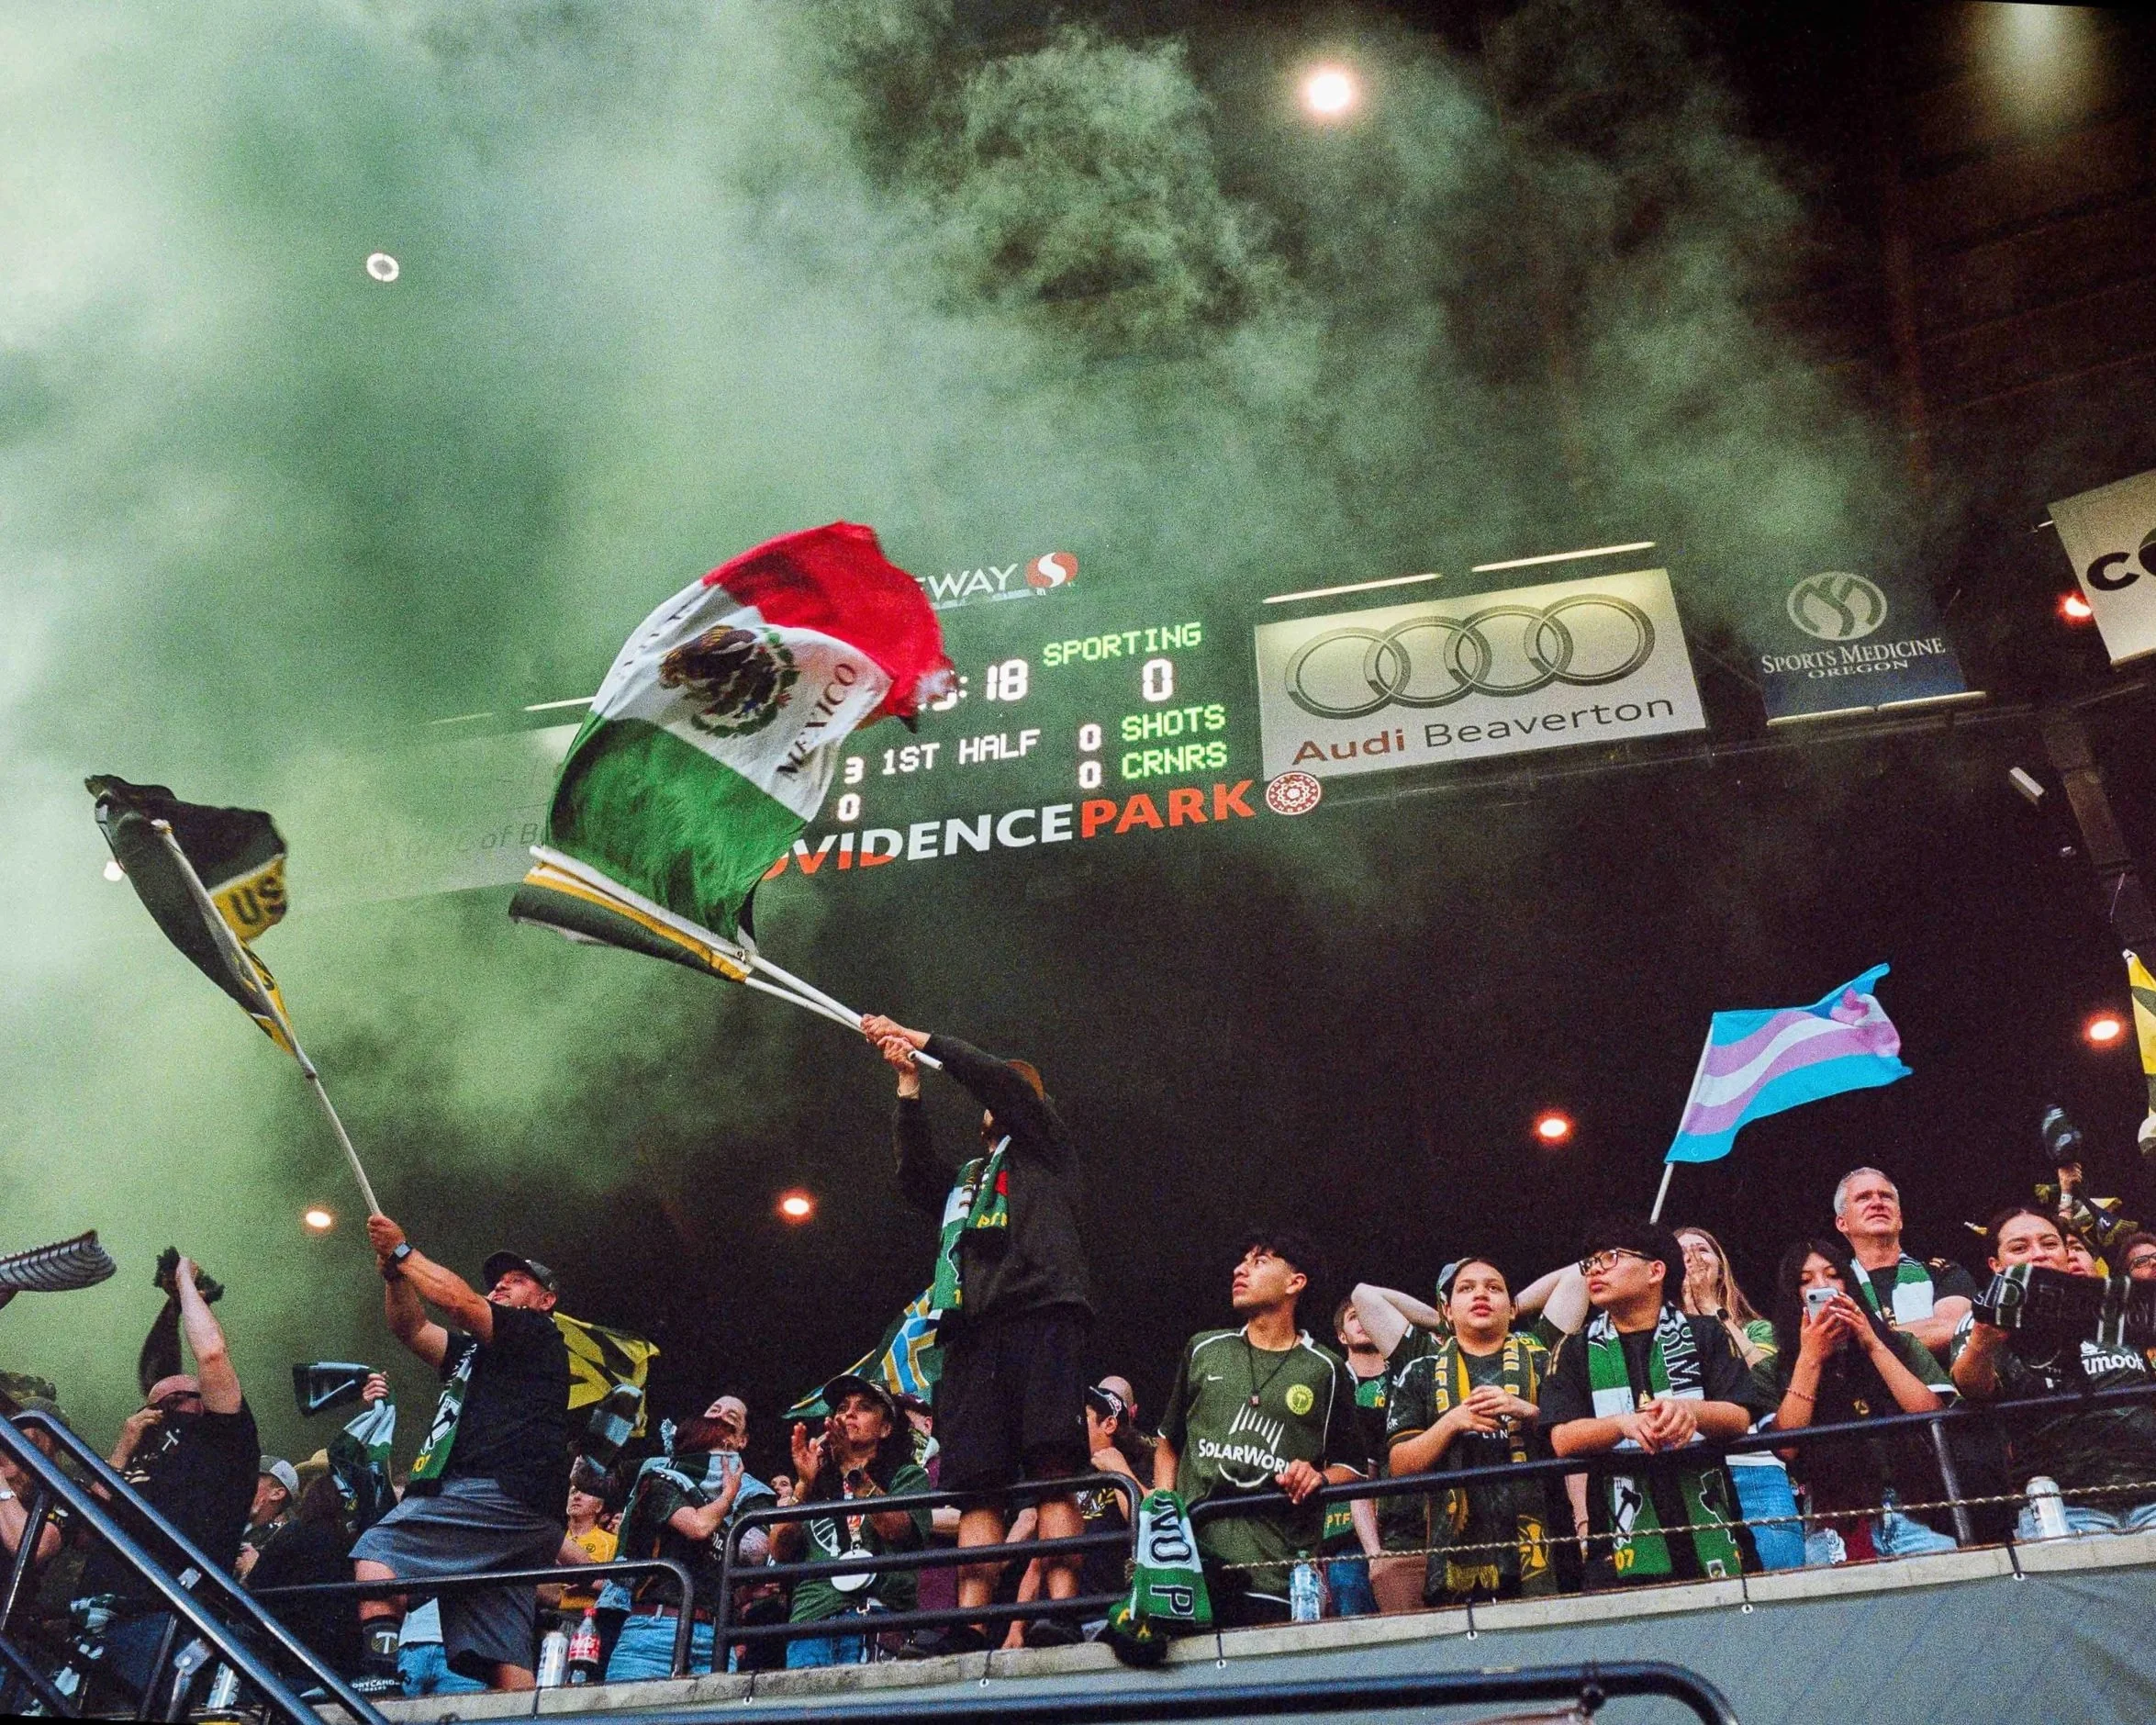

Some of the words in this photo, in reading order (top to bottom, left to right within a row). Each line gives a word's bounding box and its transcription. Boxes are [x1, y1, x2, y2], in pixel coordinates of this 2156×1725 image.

[914, 563, 1018, 600] WAY
[1044, 622, 1202, 668] SPORTING
[1761, 648, 1836, 674] SPORTS
[1838, 637, 1946, 665] MEDICINE
[1141, 658, 1174, 702] 0
[1808, 659, 1909, 679] OREGON
[1078, 723, 1102, 752] 0
[1121, 704, 1226, 742] SHOTS
[1292, 728, 1405, 766] Audi
[1424, 699, 1675, 748] Beaverton
[843, 756, 866, 785] 3
[882, 740, 940, 776] 1ST
[959, 728, 1042, 765] HALF
[1078, 760, 1102, 790] 0
[1121, 741, 1228, 780] CRNRS
[837, 793, 861, 822] 0
[1081, 778, 1257, 839] PARK
